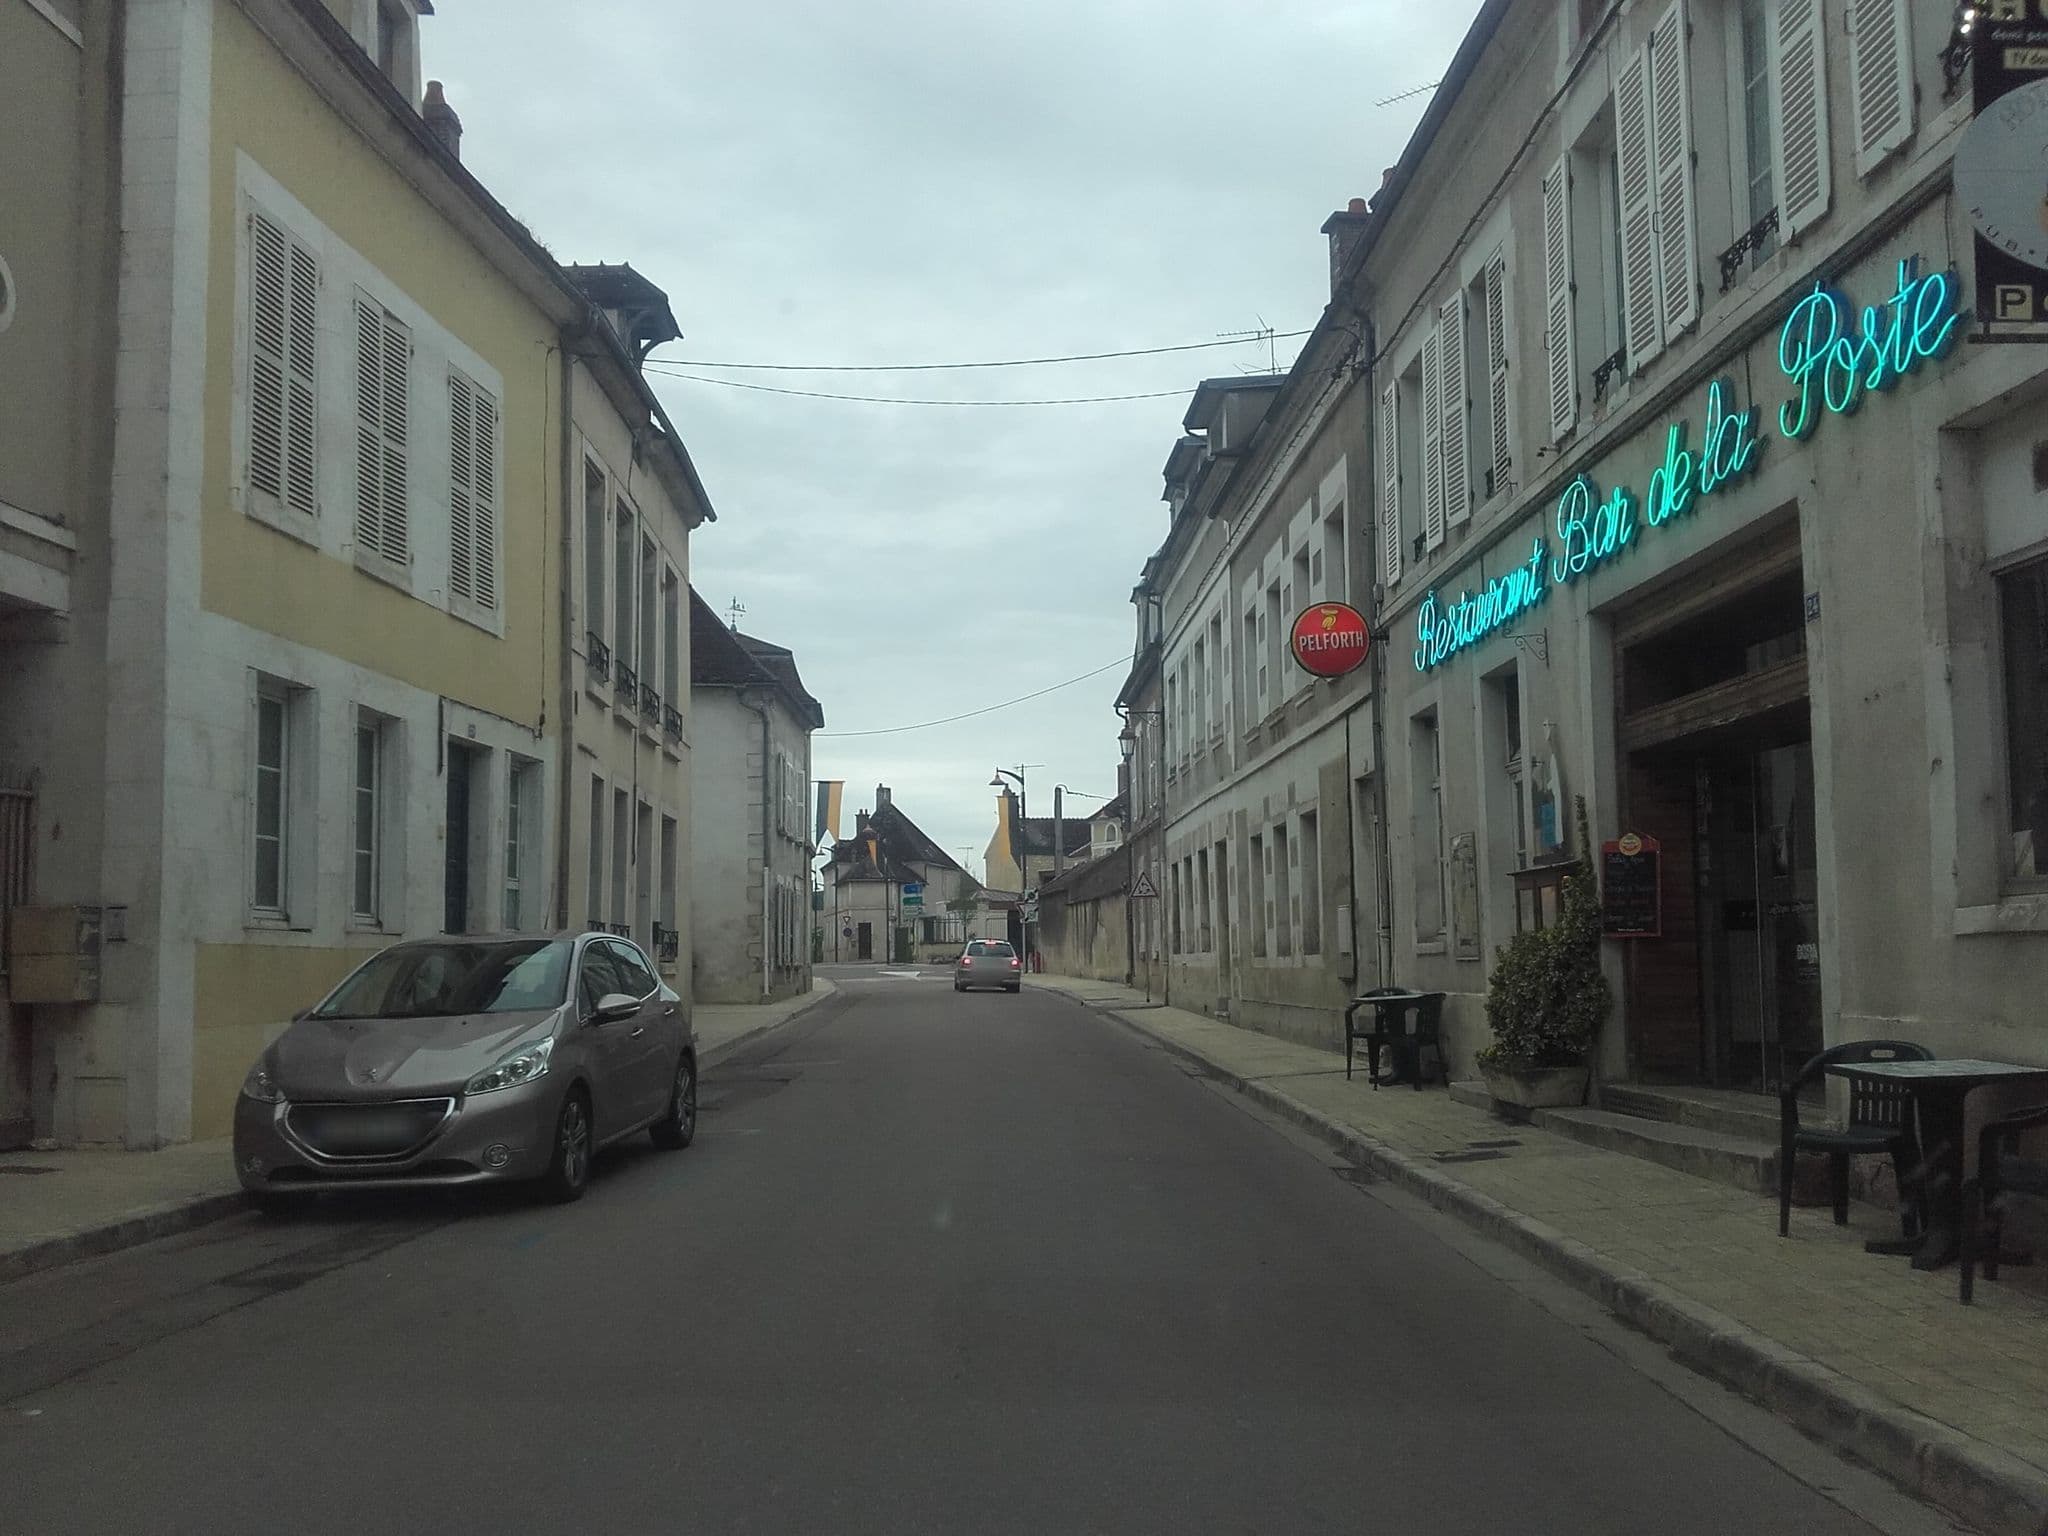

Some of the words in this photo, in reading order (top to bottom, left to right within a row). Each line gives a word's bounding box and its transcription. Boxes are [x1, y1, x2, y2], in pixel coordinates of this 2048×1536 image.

[1415, 537, 1543, 672] Restaurant
[1553, 474, 1634, 584] Bar
[1647, 423, 1692, 528] de
[1698, 380, 1756, 495] la
[1778, 259, 1958, 439] Poste
[1298, 631, 1364, 653] PELFORTH
